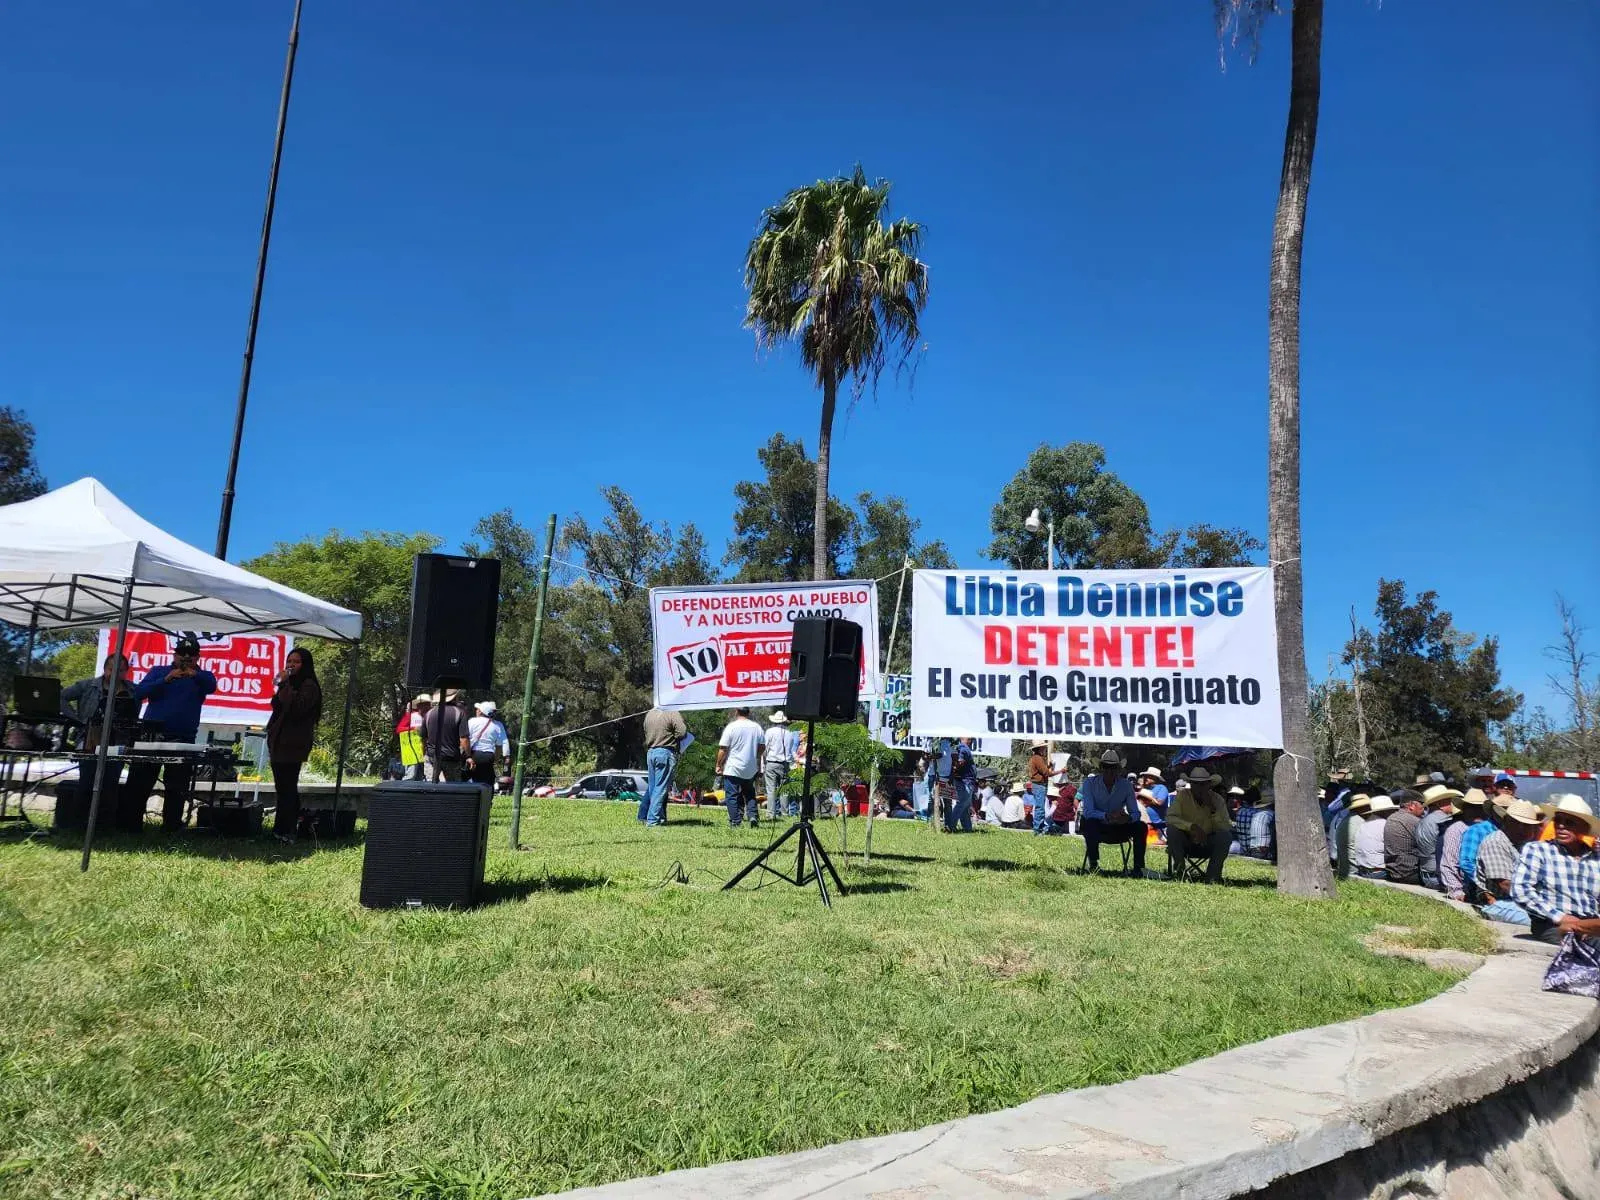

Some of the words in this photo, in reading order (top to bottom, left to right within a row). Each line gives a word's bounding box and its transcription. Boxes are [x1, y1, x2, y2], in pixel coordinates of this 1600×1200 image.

[661, 594, 785, 612] DEFENDEREMOS
[788, 594, 807, 606] AL
[811, 591, 868, 605] PUEBLO
[946, 576, 1045, 617] Libia
[1057, 574, 1244, 617] Dennise
[684, 615, 694, 627] Y
[697, 614, 709, 626] A
[713, 611, 783, 626] NUESTRO
[247, 643, 271, 660] AL
[727, 643, 749, 657] AL
[984, 625, 1195, 668] DETENTE!
[245, 664, 258, 674] de
[260, 665, 270, 675] la
[673, 647, 719, 681] NO
[216, 677, 262, 695] OLIS
[928, 667, 952, 698] El
[960, 673, 1011, 700] sur
[1018, 670, 1058, 701] de
[1066, 670, 1261, 707] Guanajuato
[986, 706, 1113, 737] también
[1119, 709, 1198, 739] vale!
